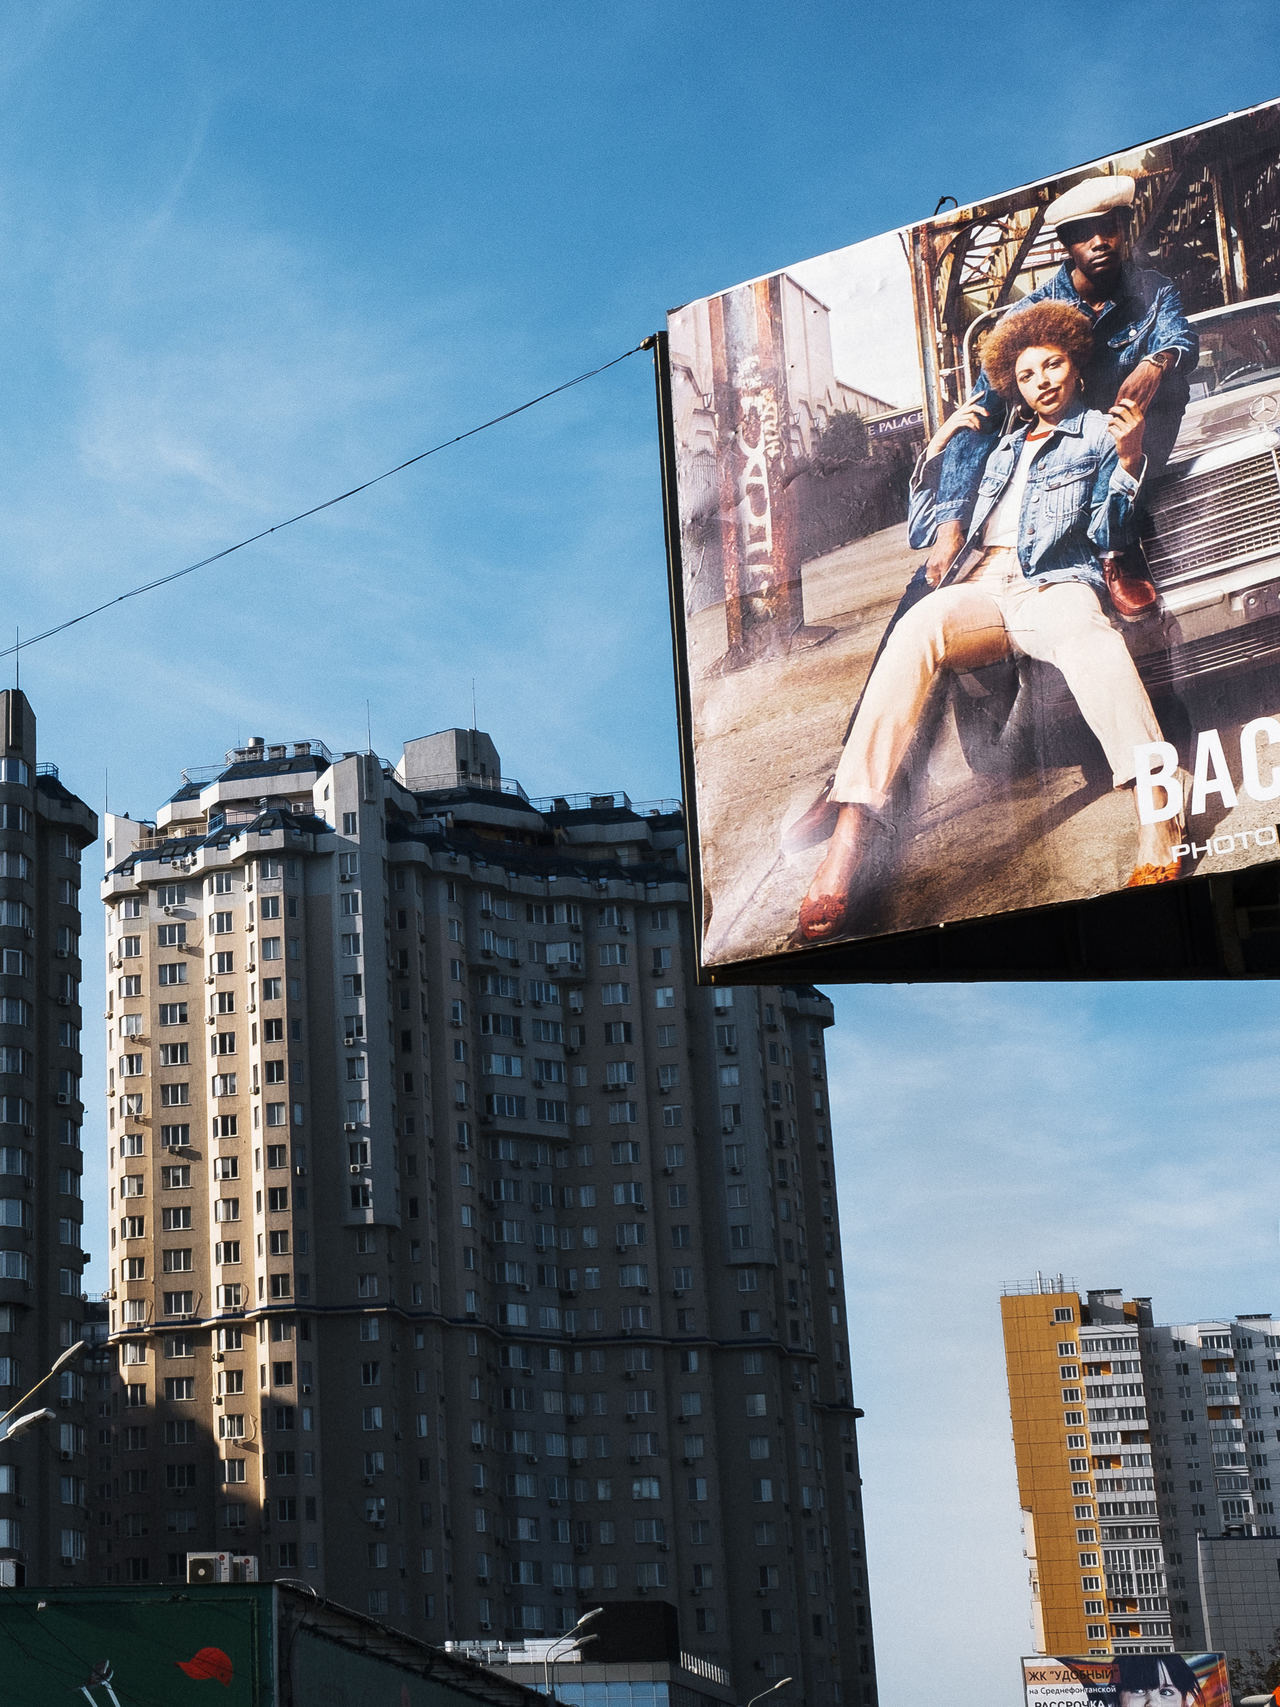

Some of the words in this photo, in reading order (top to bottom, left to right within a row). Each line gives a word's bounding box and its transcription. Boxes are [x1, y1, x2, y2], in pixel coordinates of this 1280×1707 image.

[878, 411, 924, 433] PALACE
[1171, 826, 1277, 863] PHOTO
[1028, 1671, 1047, 1681] ЖК
[1040, 1685, 1117, 1695] Среднефонтанской
